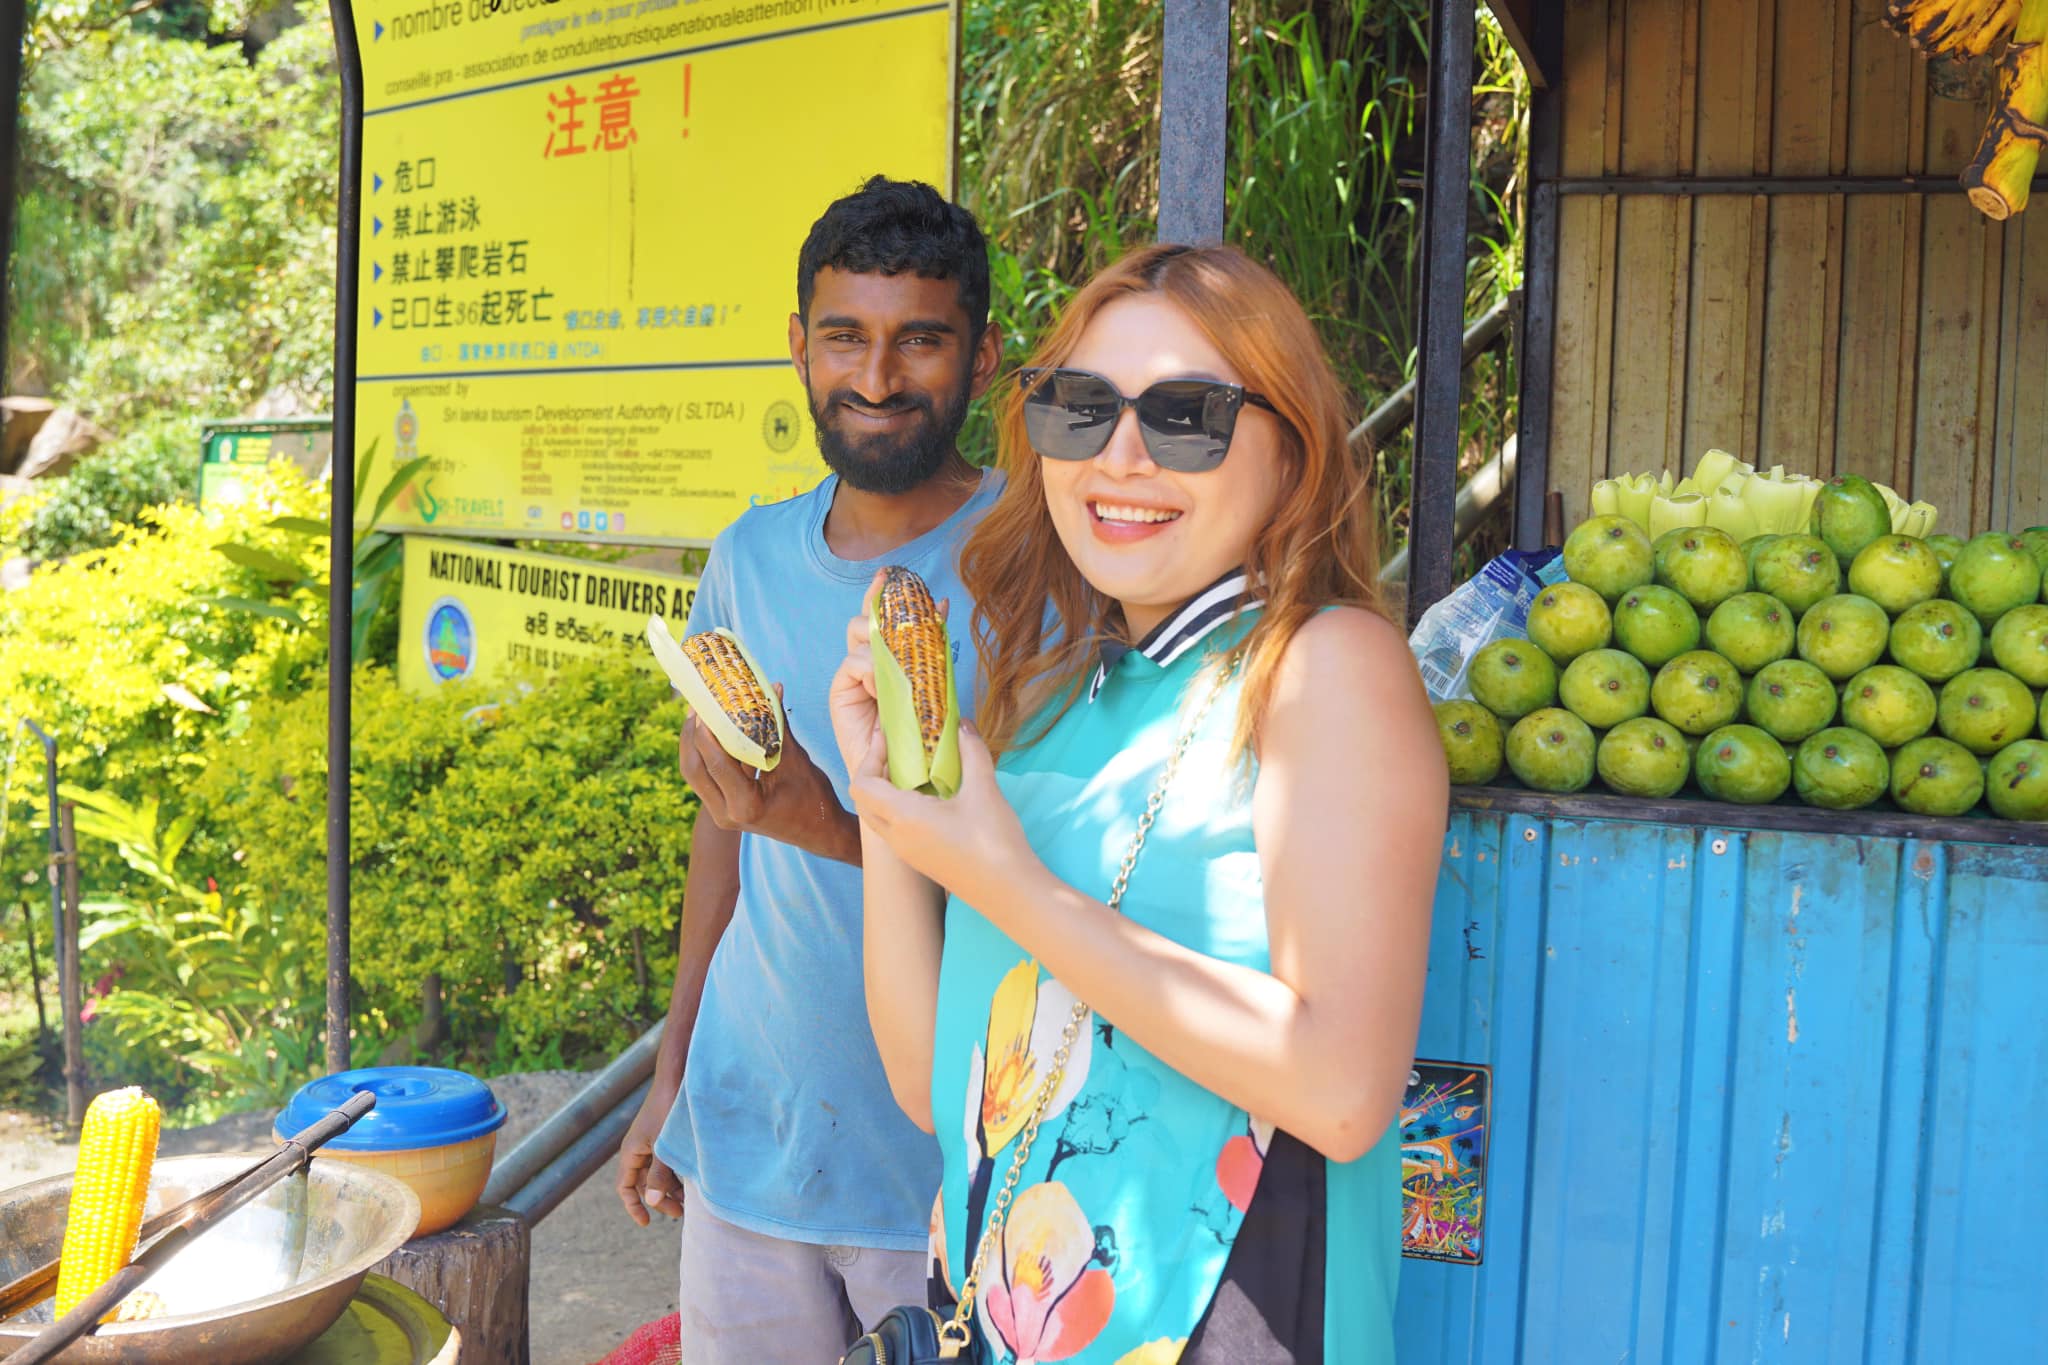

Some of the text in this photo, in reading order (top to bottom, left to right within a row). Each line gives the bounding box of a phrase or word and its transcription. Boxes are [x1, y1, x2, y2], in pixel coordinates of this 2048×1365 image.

[391, 0, 462, 40] nombre
[463, 52, 529, 80] association
[533, 47, 548, 64] de
[392, 196, 481, 239] 禁止游泳
[391, 239, 529, 285] 禁止攀爬岩石
[443, 407, 458, 423] Sri
[491, 406, 532, 422] tourism
[535, 404, 613, 425] Development
[617, 402, 674, 424] Authority
[685, 401, 735, 421] SLTDA
[429, 550, 503, 590] NATIONAL
[509, 563, 581, 602] TOURIST
[585, 575, 666, 617] DRIVERS
